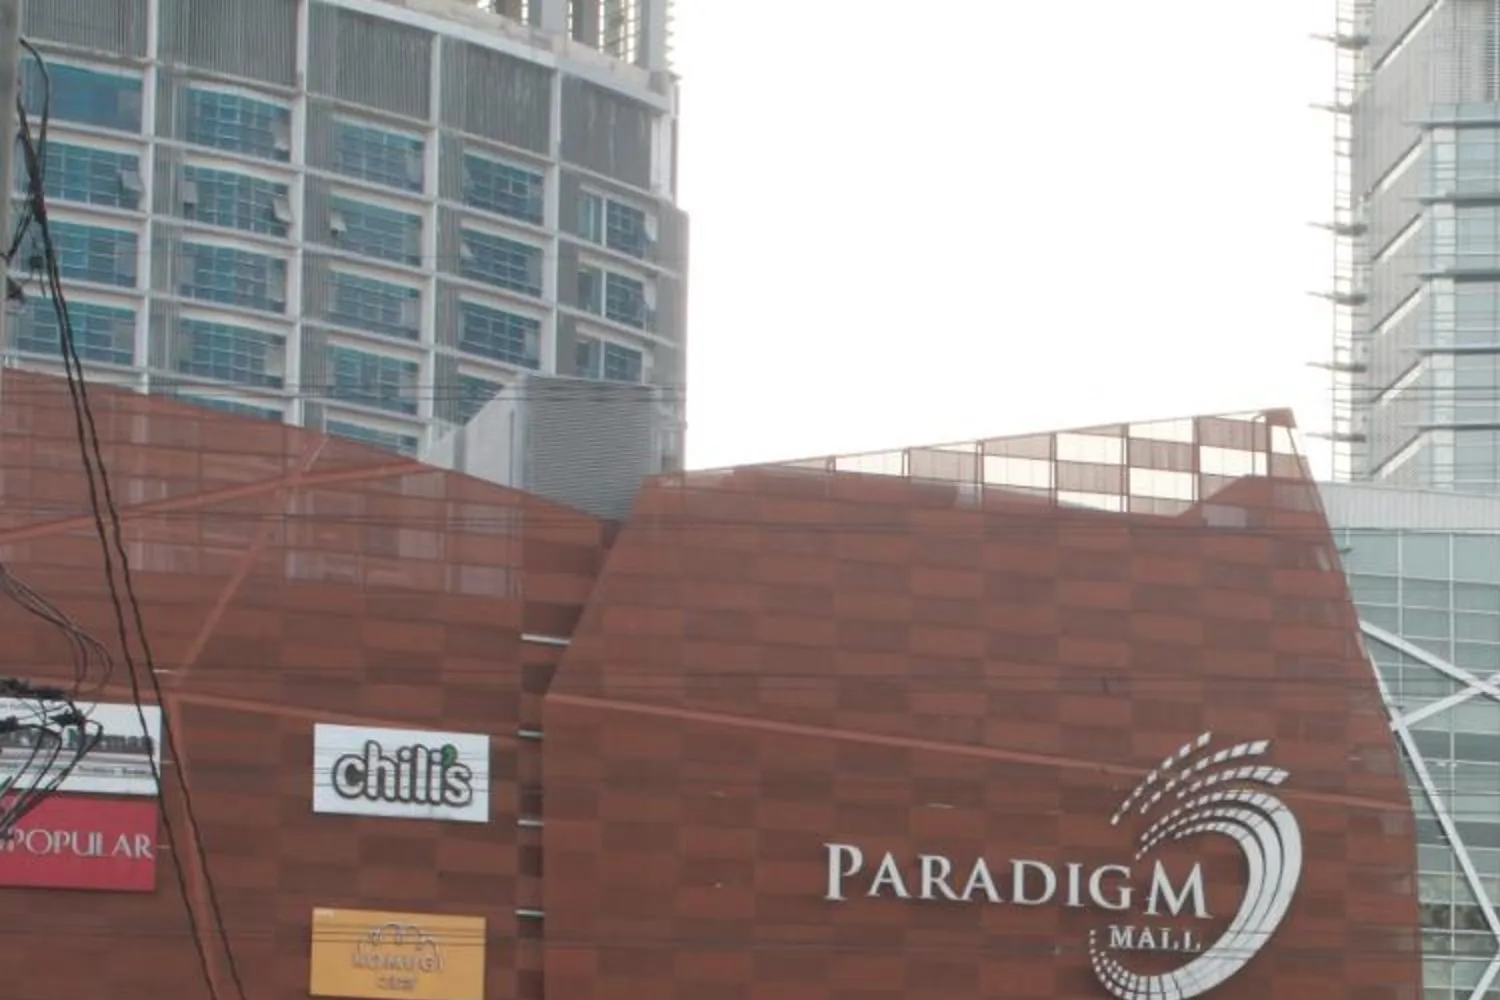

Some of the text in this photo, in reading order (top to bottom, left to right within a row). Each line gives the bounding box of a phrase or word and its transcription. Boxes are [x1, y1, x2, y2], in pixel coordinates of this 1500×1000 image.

[332, 740, 473, 807] chili's
[823, 843, 1212, 919] PARADIGM
[1108, 926, 1201, 953] MALL
